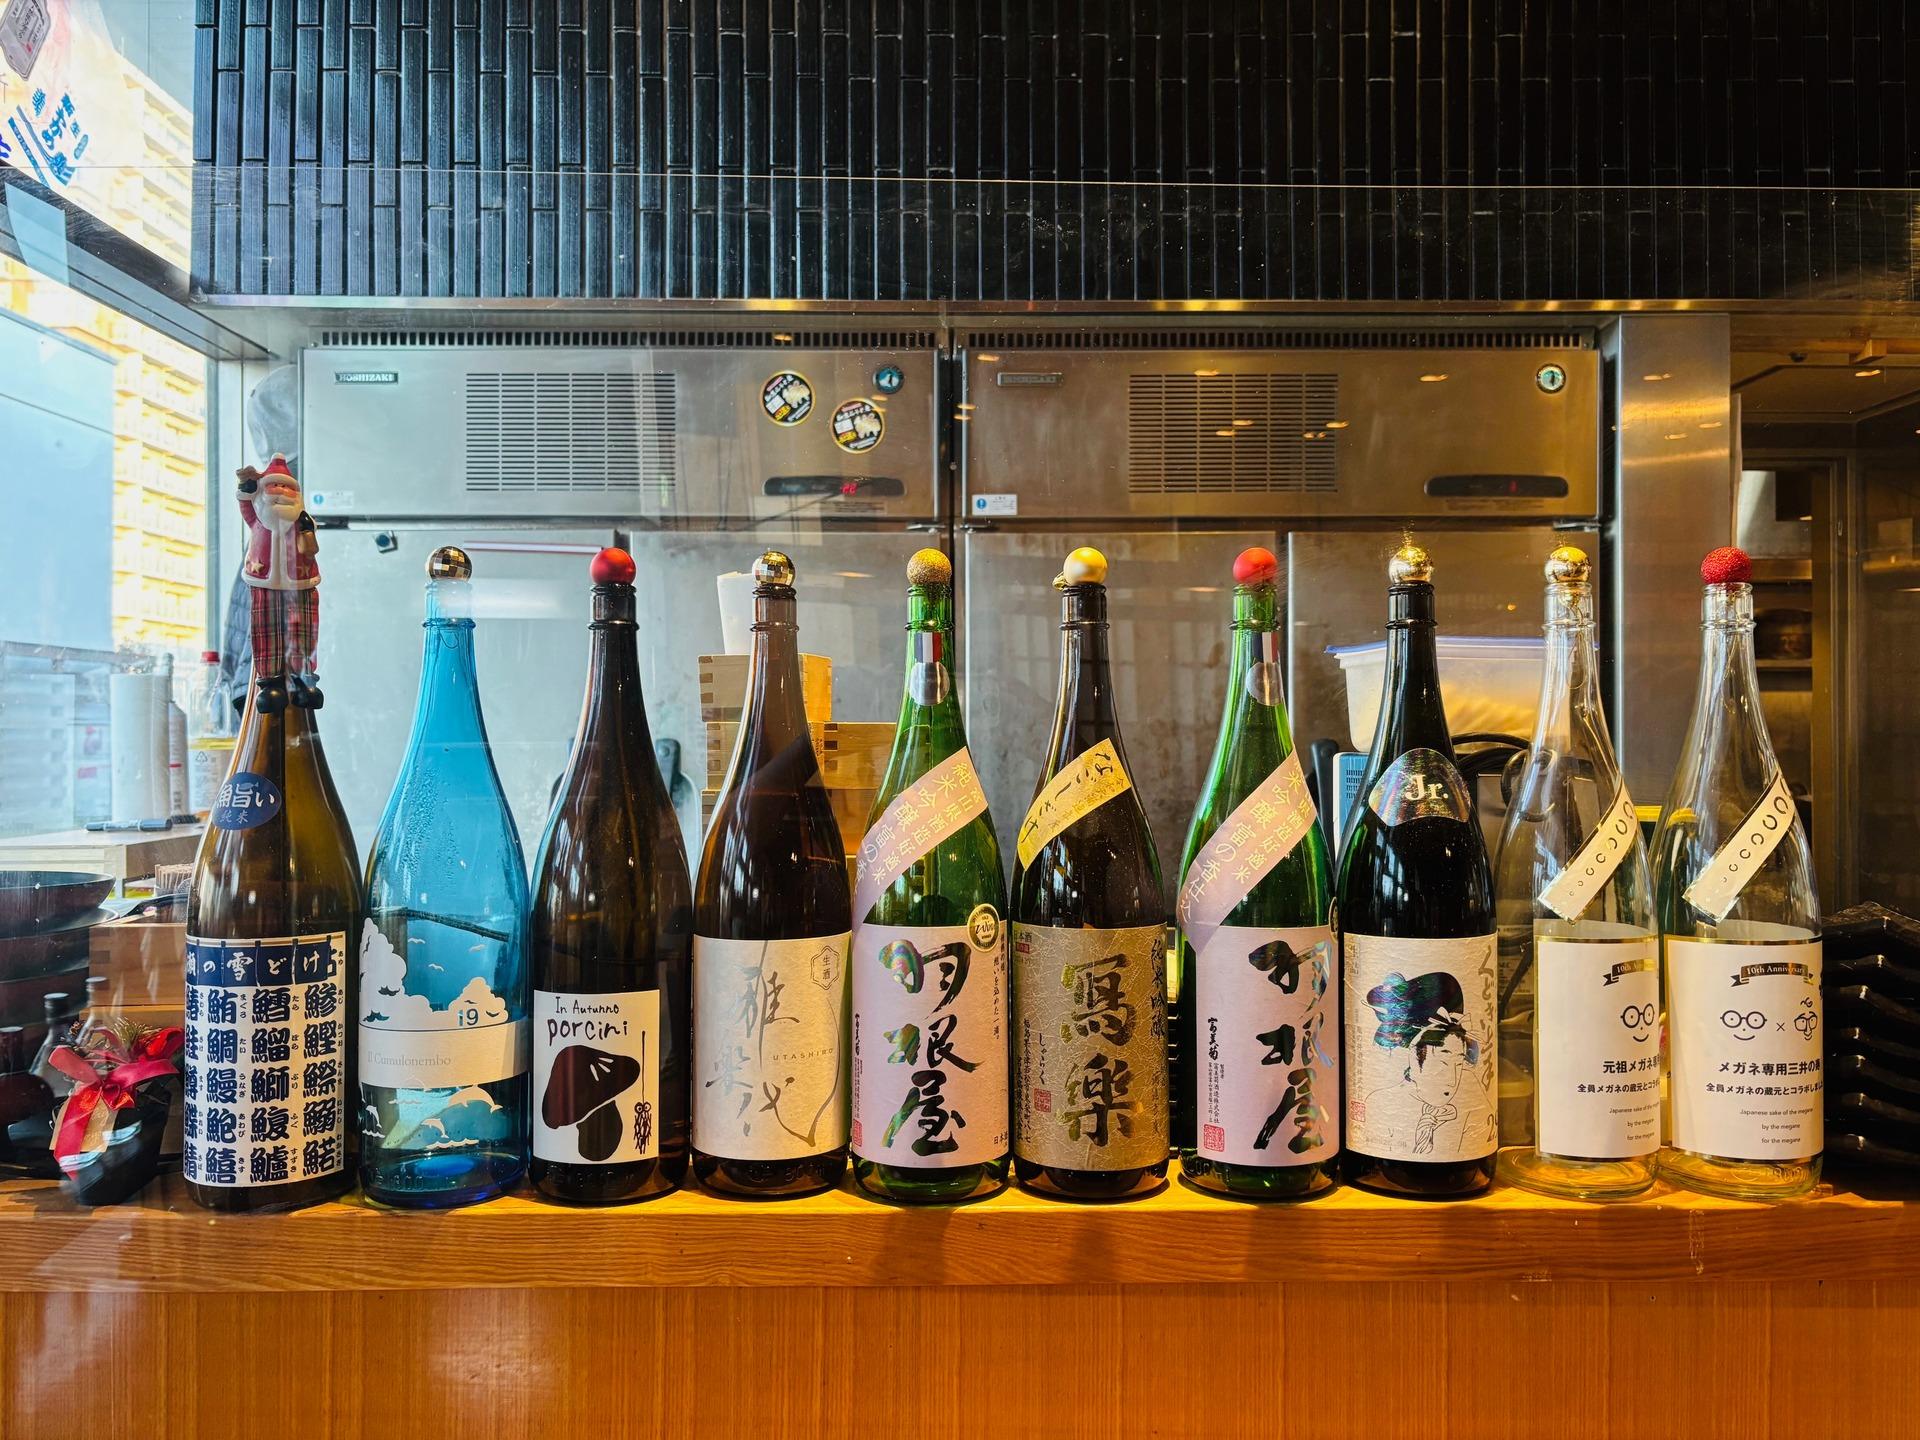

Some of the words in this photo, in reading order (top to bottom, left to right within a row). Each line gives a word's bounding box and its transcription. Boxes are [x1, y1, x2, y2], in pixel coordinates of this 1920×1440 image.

[1405, 774, 1449, 799] Jr.
[220, 809, 248, 824] 純米
[1746, 966, 1765, 975] 10th
[208, 988, 237, 1024] 鮪
[252, 987, 290, 1023] 鱈
[555, 996, 567, 1014] In
[207, 1028, 237, 1064] 鯛
[304, 1020, 336, 1058] 鰹
[548, 1018, 628, 1046] porcini
[878, 939, 985, 1156] 羽根屋
[1249, 940, 1334, 1154] 羽根屋
[375, 1053, 451, 1066] Cumulonembo
[773, 1047, 834, 1061] UTASHIRO
[207, 1068, 237, 1103] 鰻
[251, 1066, 289, 1103] 鰤
[207, 1108, 236, 1143] 鮑
[303, 1098, 336, 1137] 鰯
[250, 1146, 288, 1183] 鱸
